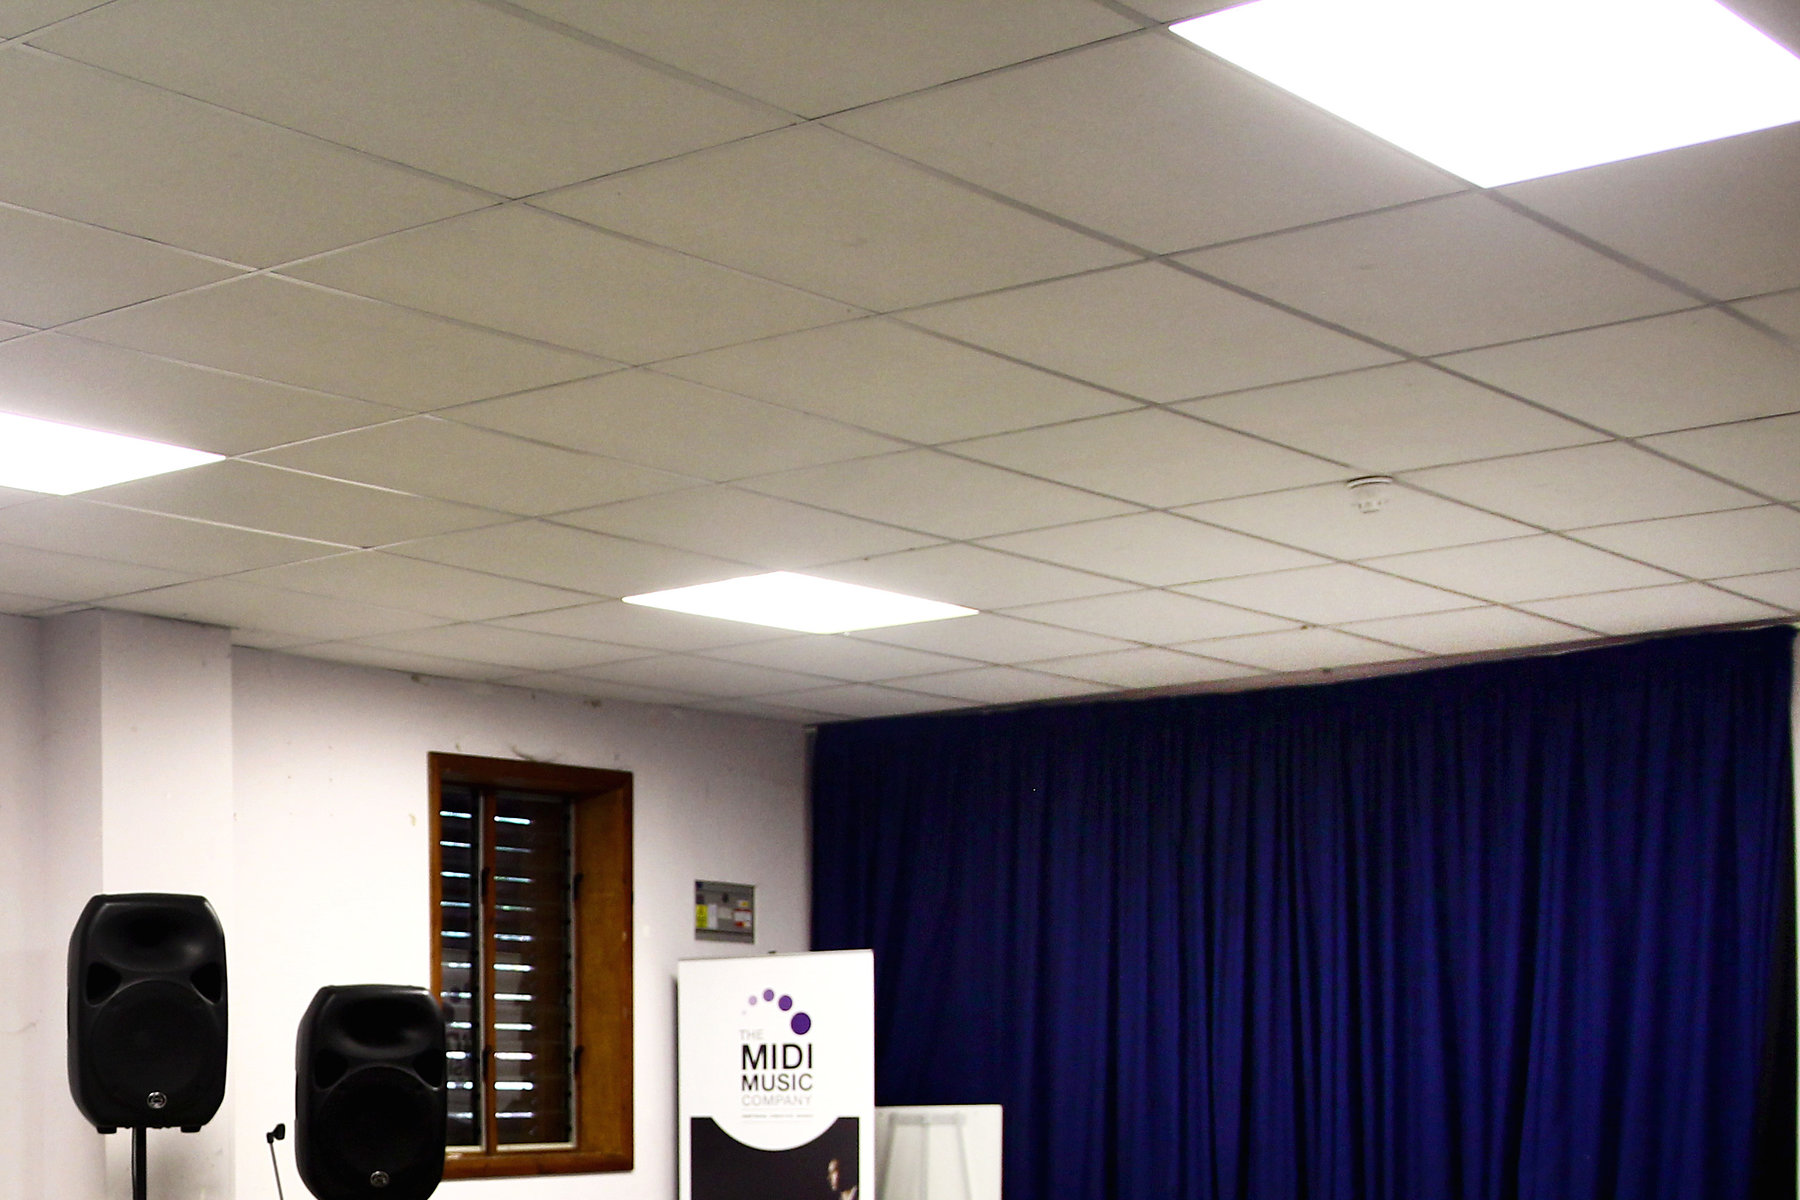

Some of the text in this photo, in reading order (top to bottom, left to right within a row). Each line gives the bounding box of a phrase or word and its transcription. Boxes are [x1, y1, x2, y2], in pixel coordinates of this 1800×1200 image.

[739, 1029, 764, 1040] THE
[740, 1043, 813, 1070] MIDI
[740, 1073, 813, 1092] MUSIC
[740, 1094, 812, 1106] COMPANY
